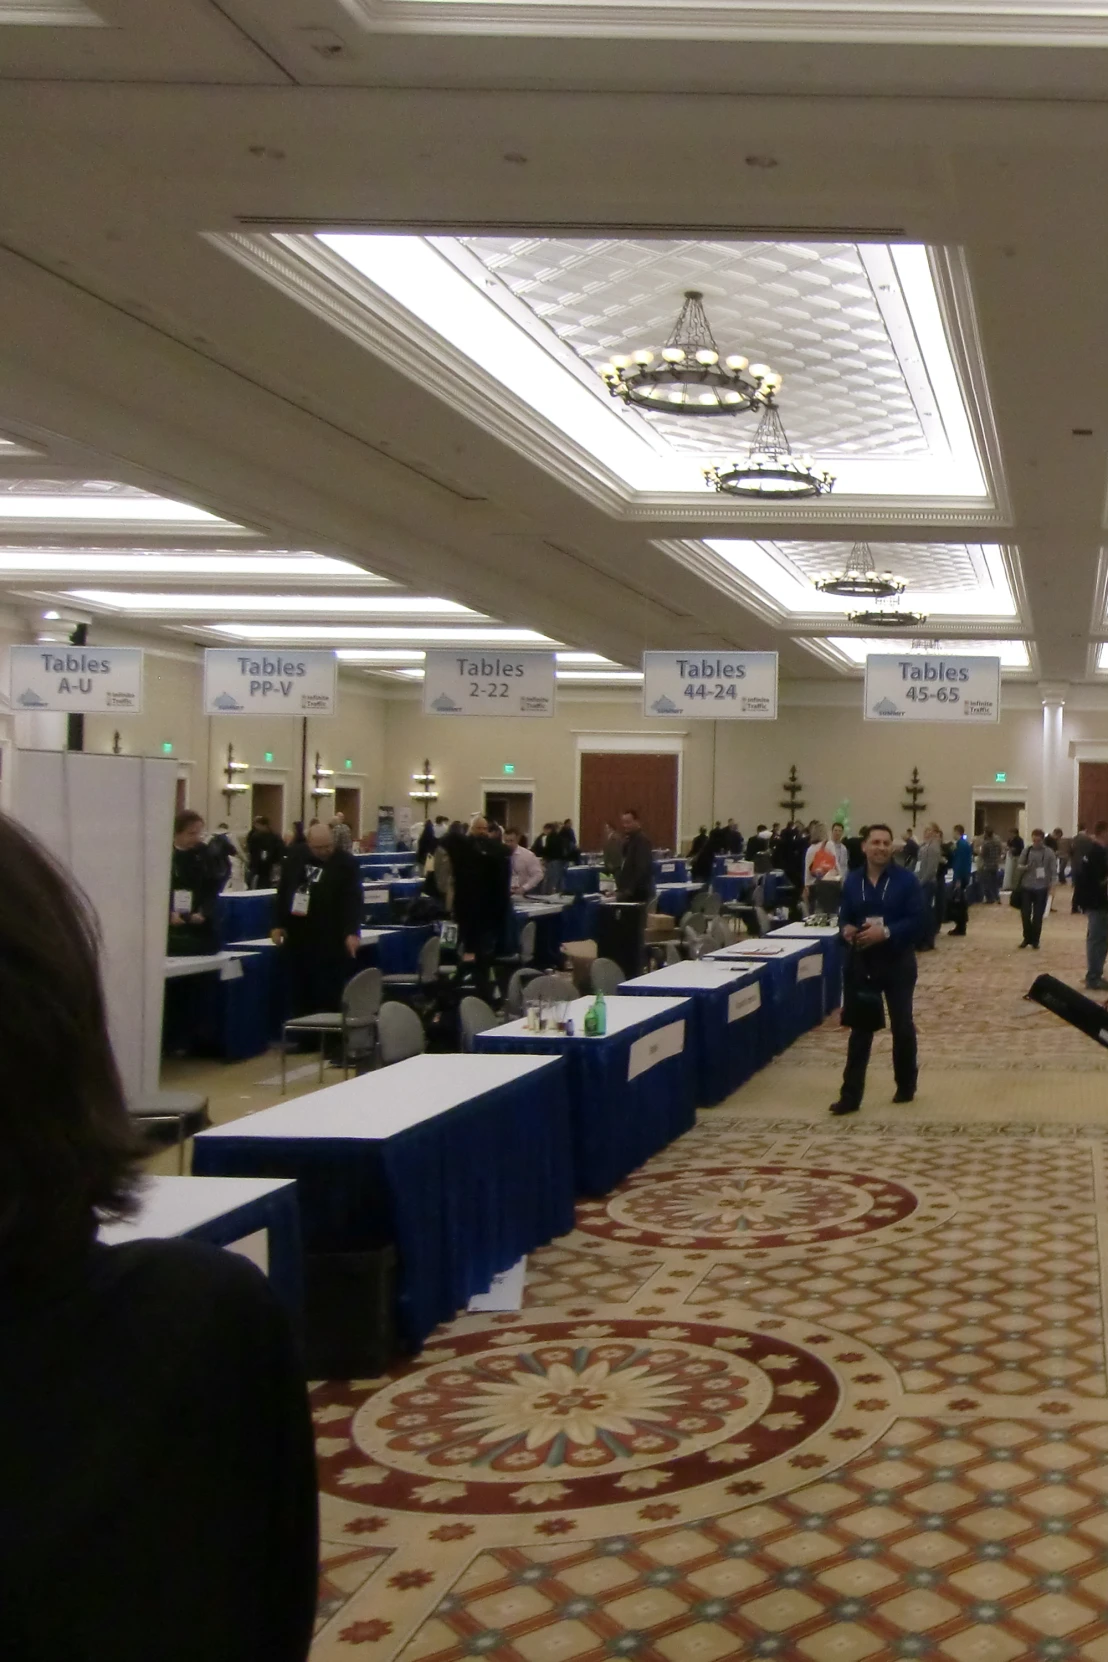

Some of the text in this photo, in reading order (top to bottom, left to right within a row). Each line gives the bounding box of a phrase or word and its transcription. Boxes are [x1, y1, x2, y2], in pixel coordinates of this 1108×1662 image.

[41, 654, 111, 674] Tables
[237, 657, 306, 676] Tables
[456, 658, 524, 677] Tables
[676, 659, 746, 679] Tables
[898, 661, 969, 682] Tables
[58, 678, 93, 694] A-U
[250, 680, 293, 697] PP-V
[469, 682, 509, 698] 2-22
[684, 684, 737, 700] 44-24
[906, 687, 960, 703] 45-65
